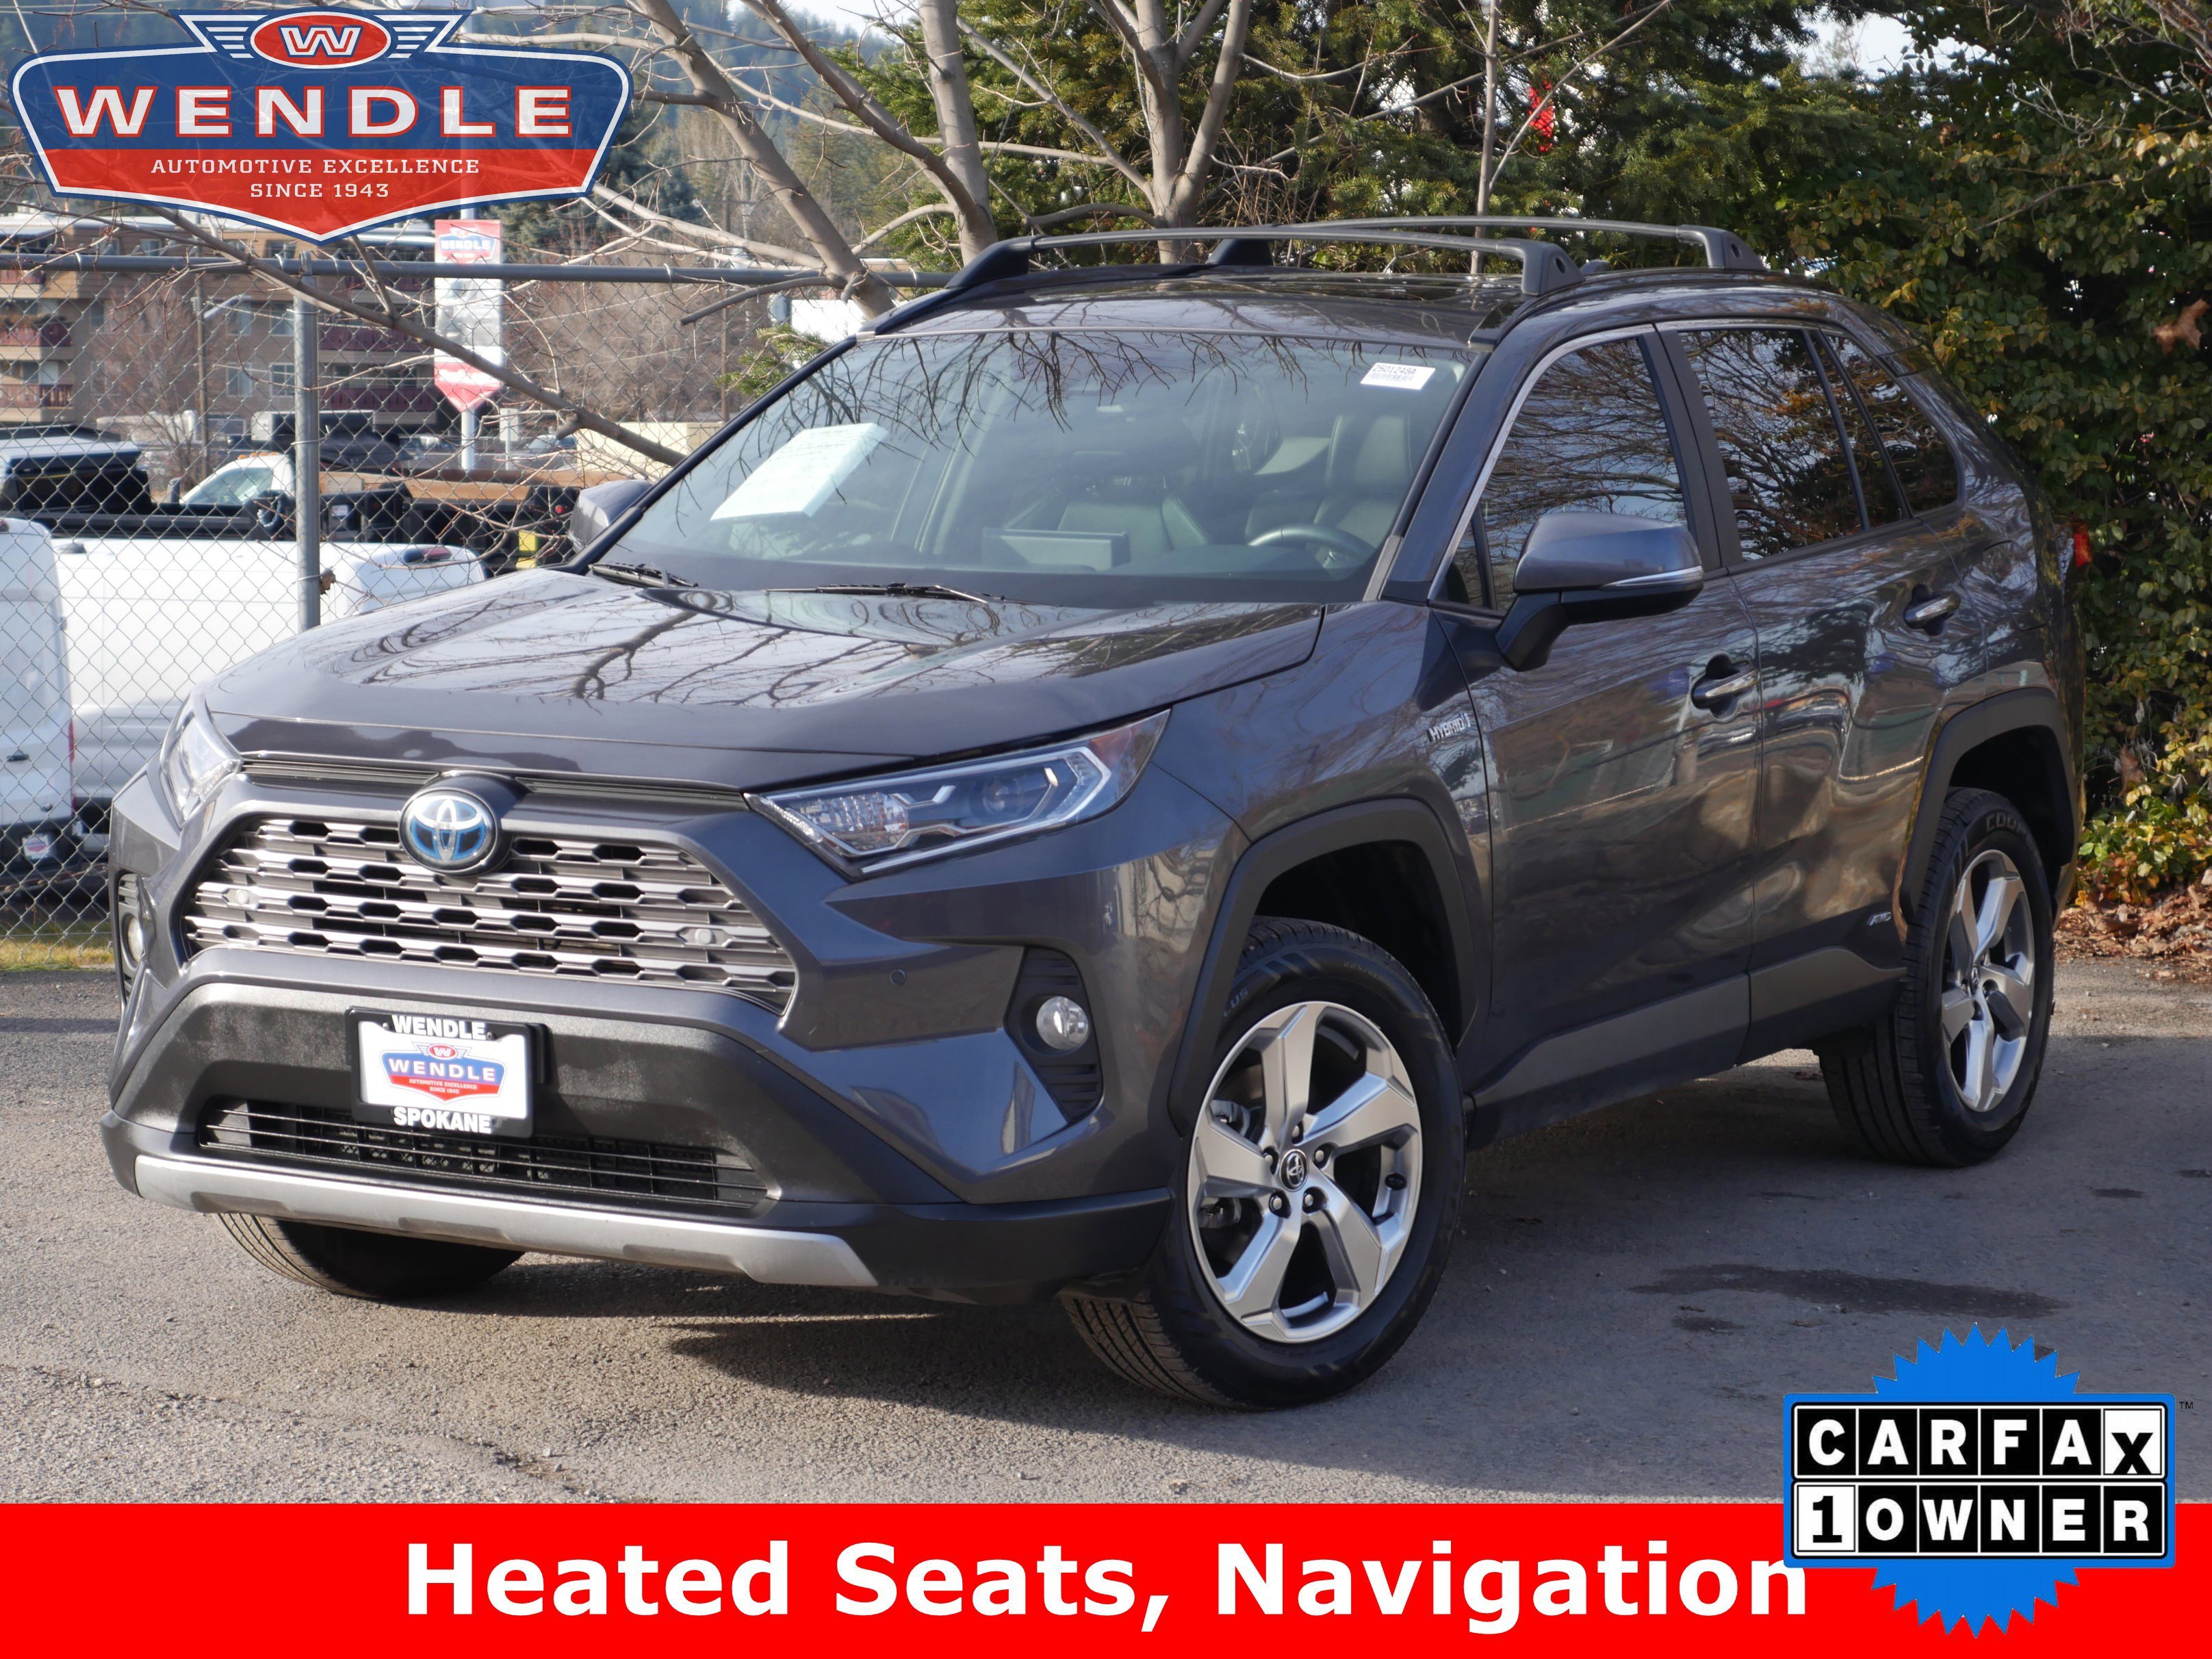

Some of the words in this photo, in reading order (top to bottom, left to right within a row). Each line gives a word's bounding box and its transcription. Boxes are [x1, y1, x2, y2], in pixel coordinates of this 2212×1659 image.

[440, 240, 491, 250] WENDLE
[1429, 717, 1465, 741] HYBRID
[391, 1014, 487, 1040] WENDLE
[388, 1058, 496, 1082] WENDLE
[409, 1078, 443, 1087] AUTOMOTIVE
[444, 1081, 478, 1090] EXCELLENCE
[394, 1106, 492, 1134] SPOKANE
